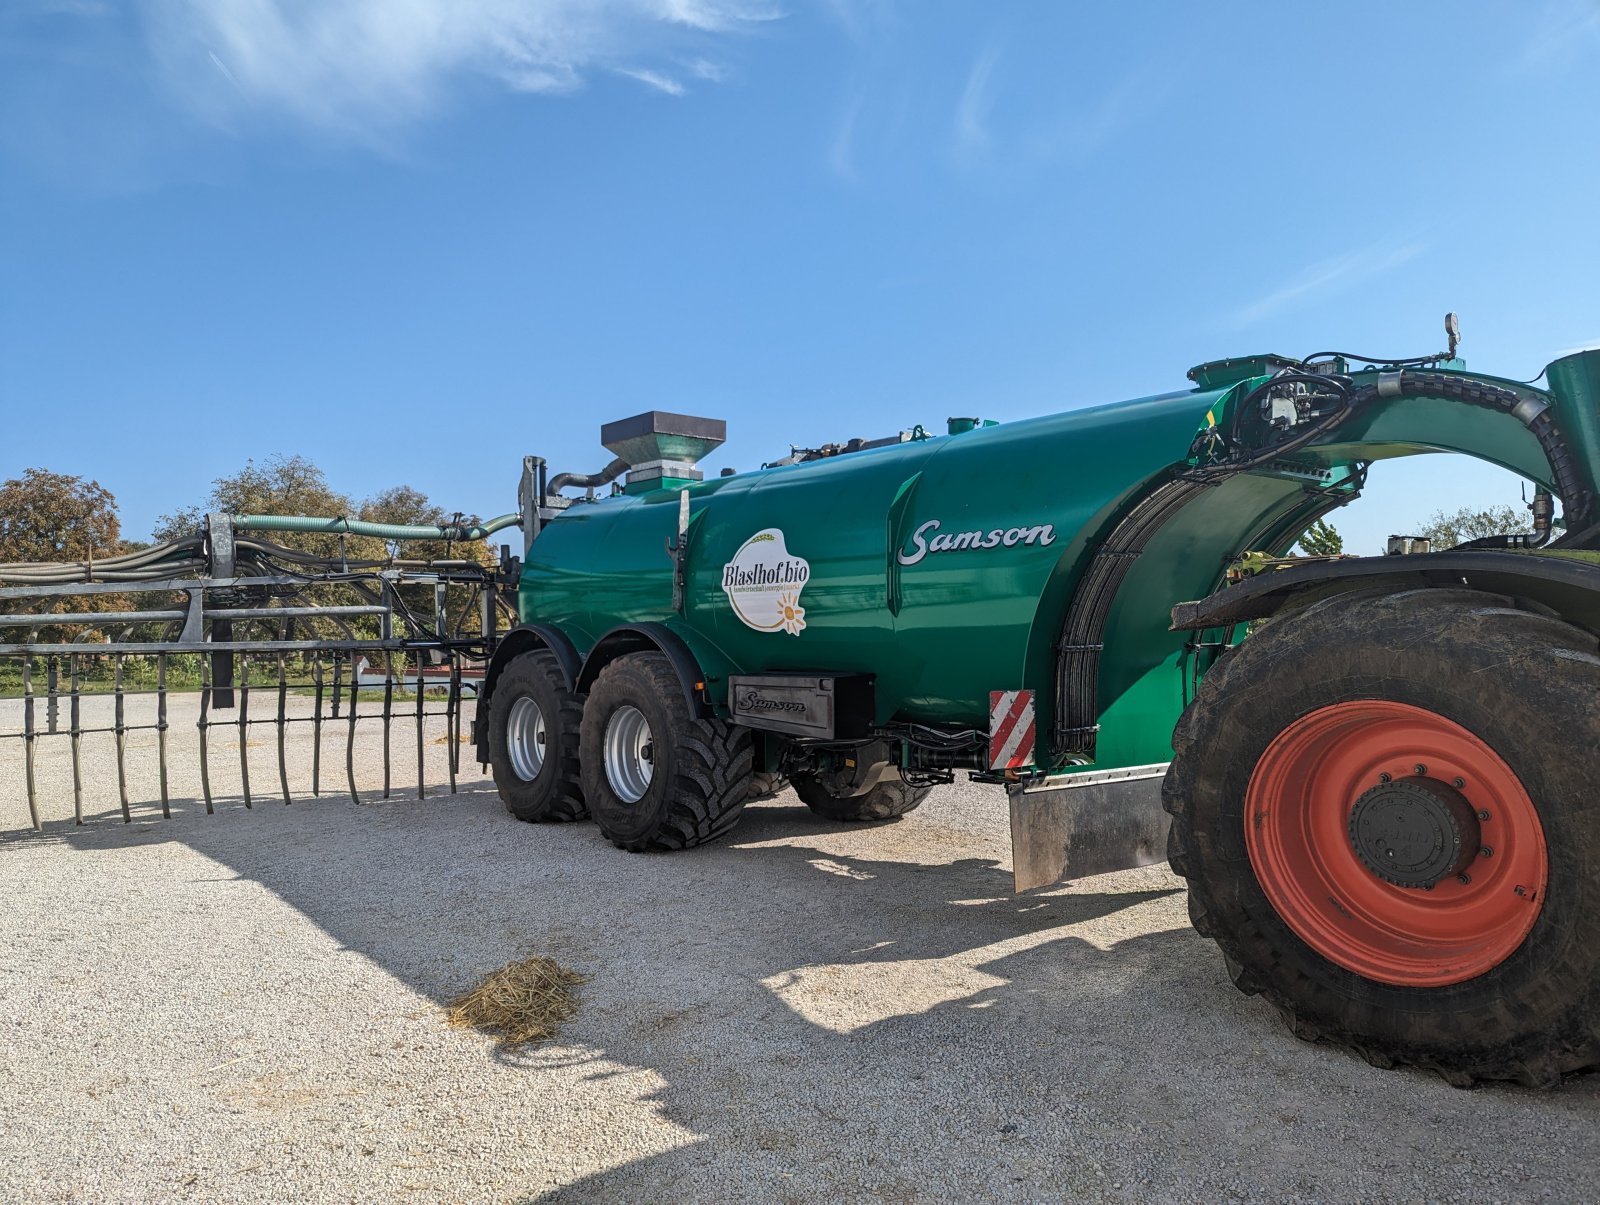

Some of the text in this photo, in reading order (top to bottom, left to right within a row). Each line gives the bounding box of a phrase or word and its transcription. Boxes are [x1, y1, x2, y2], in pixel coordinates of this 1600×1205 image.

[897, 519, 1056, 566] Samson
[724, 561, 808, 587] Blaslhof.bio
[738, 691, 807, 712] Samson
